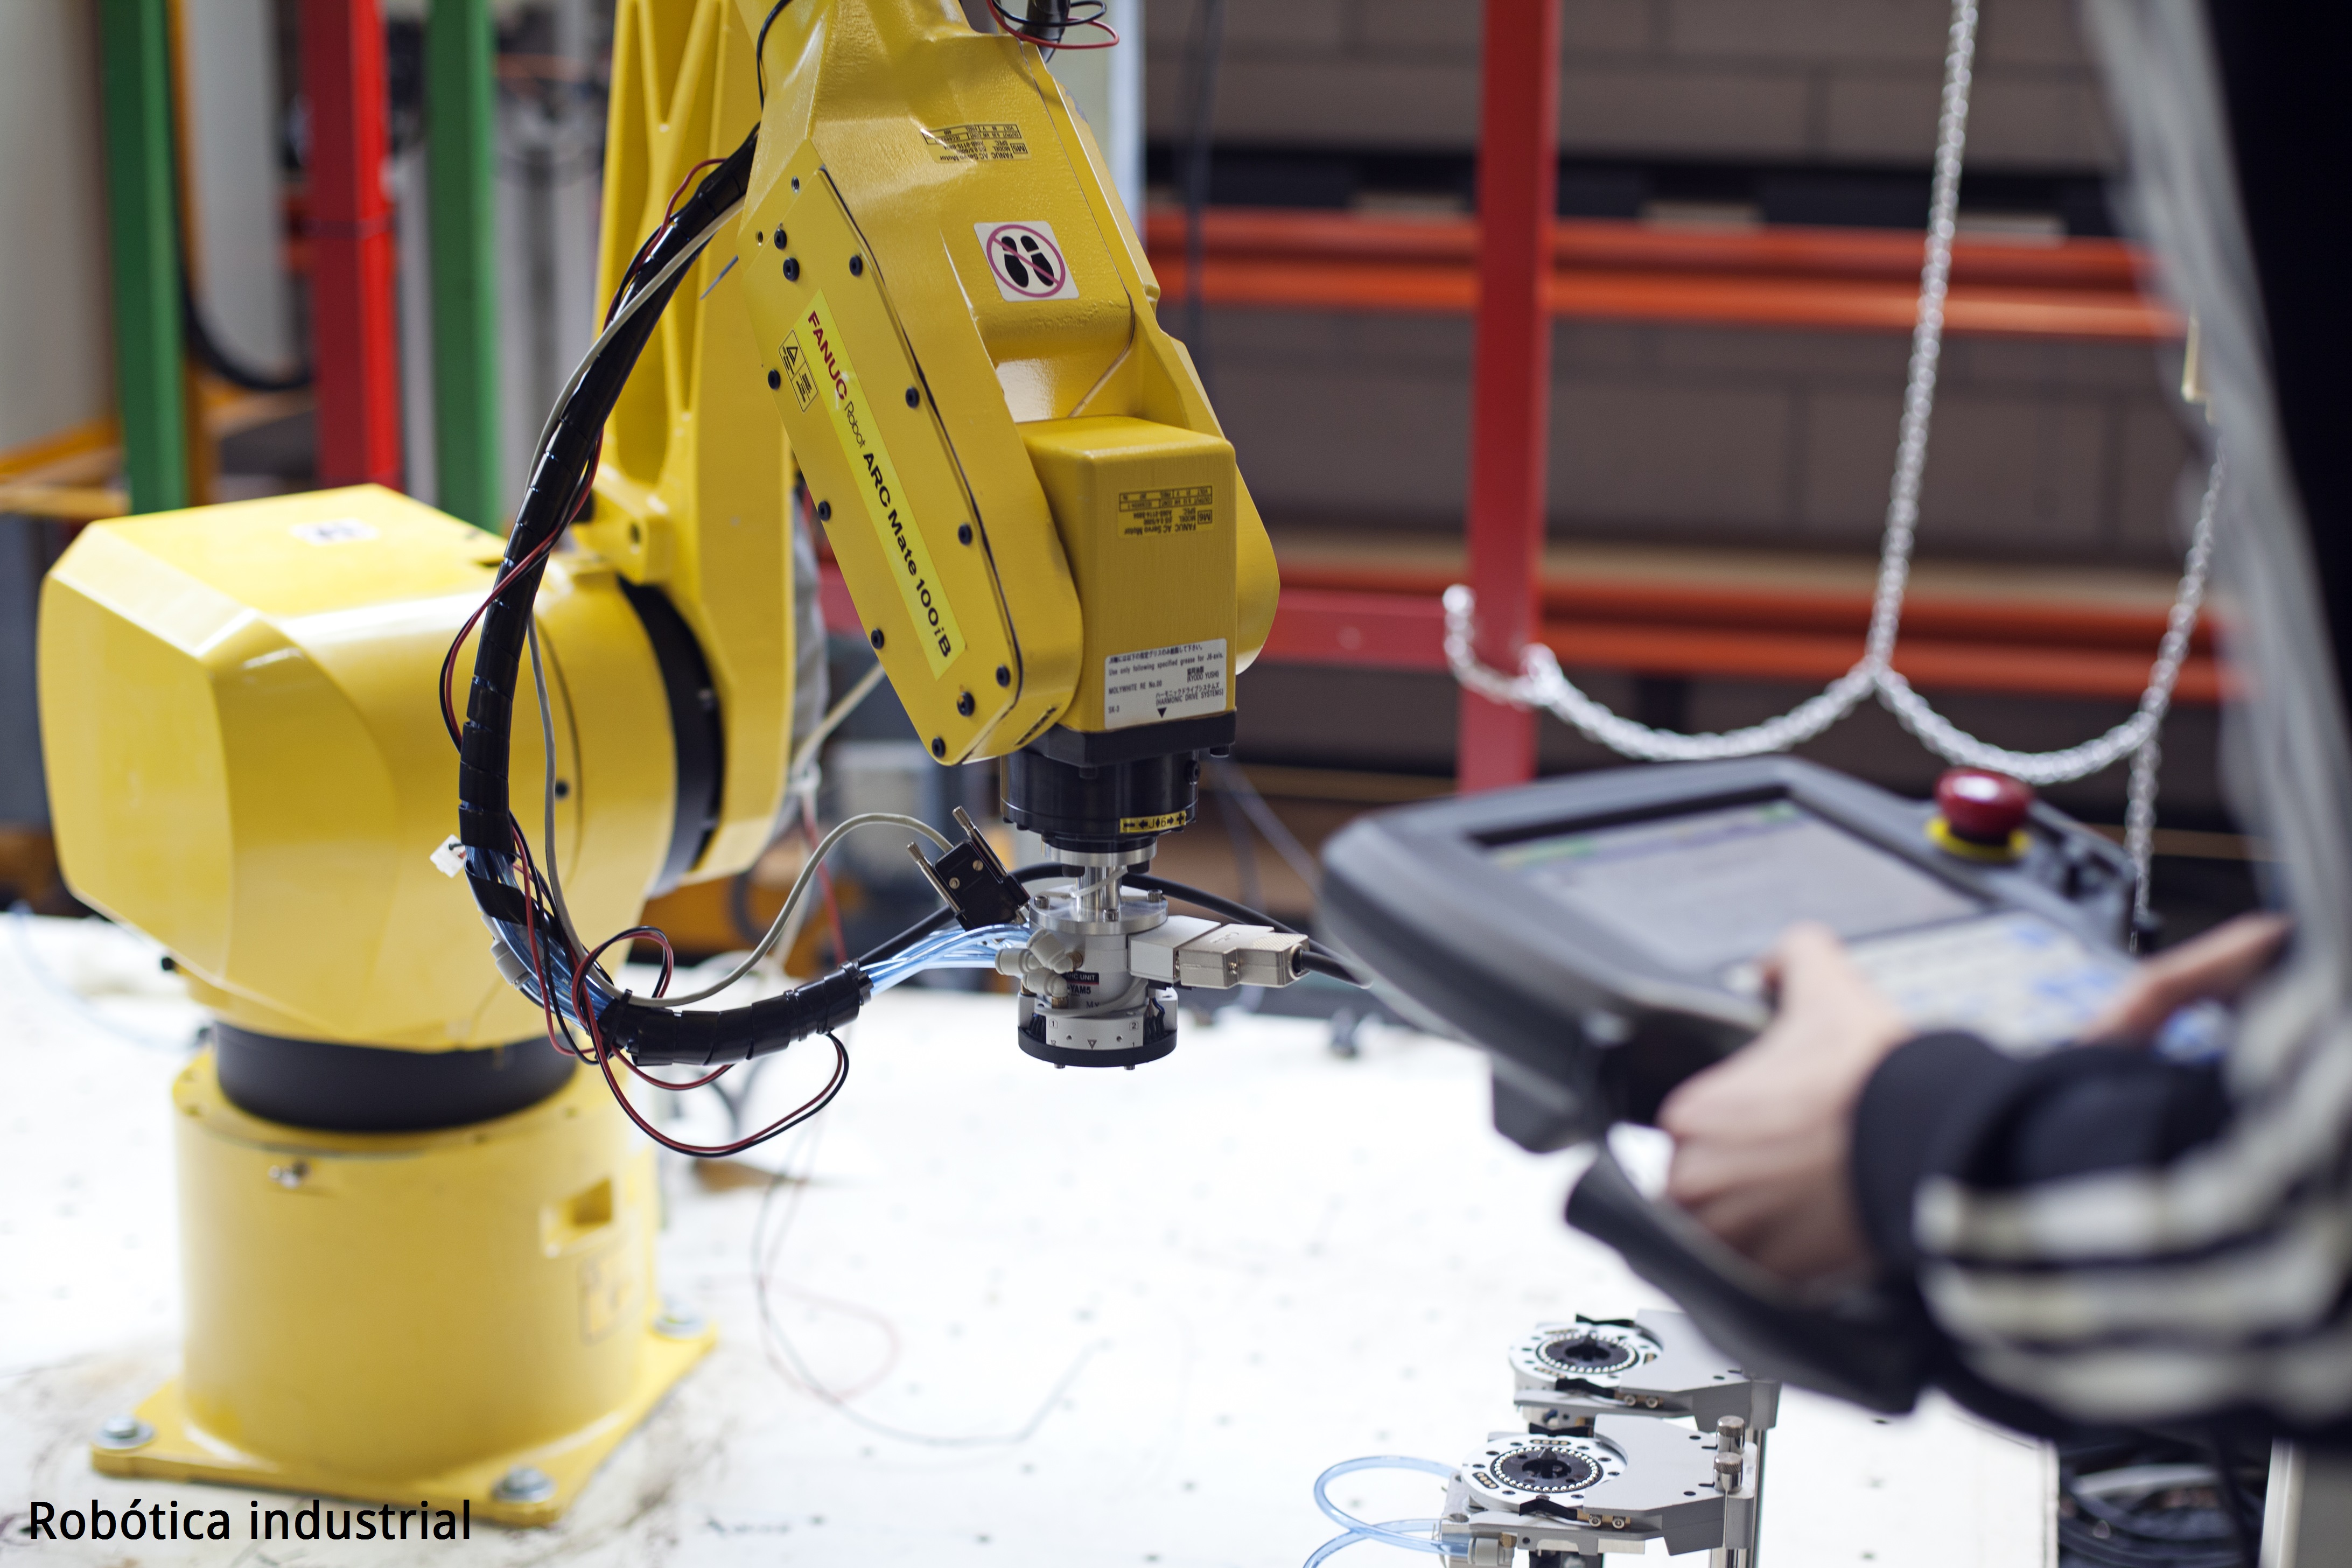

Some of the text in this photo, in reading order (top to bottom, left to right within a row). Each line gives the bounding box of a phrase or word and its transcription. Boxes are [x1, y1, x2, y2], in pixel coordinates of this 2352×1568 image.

[808, 310, 951, 657] FANUC Robot ARC Mate 100iB
[1199, 513, 1210, 522] M6
[1163, 525, 1172, 533] AC
[1175, 523, 1196, 532] FANUC
[1109, 669, 1118, 677] Use
[1120, 666, 1130, 675] only
[1133, 662, 1154, 673] following
[1157, 659, 1178, 669] specified
[1180, 658, 1195, 666] grease
[1109, 683, 1137, 695] MOLYWHITE
[1156, 688, 1224, 707] (HARMONIC DRIVE SYSTEMS)
[1108, 705, 1119, 714] SK-3
